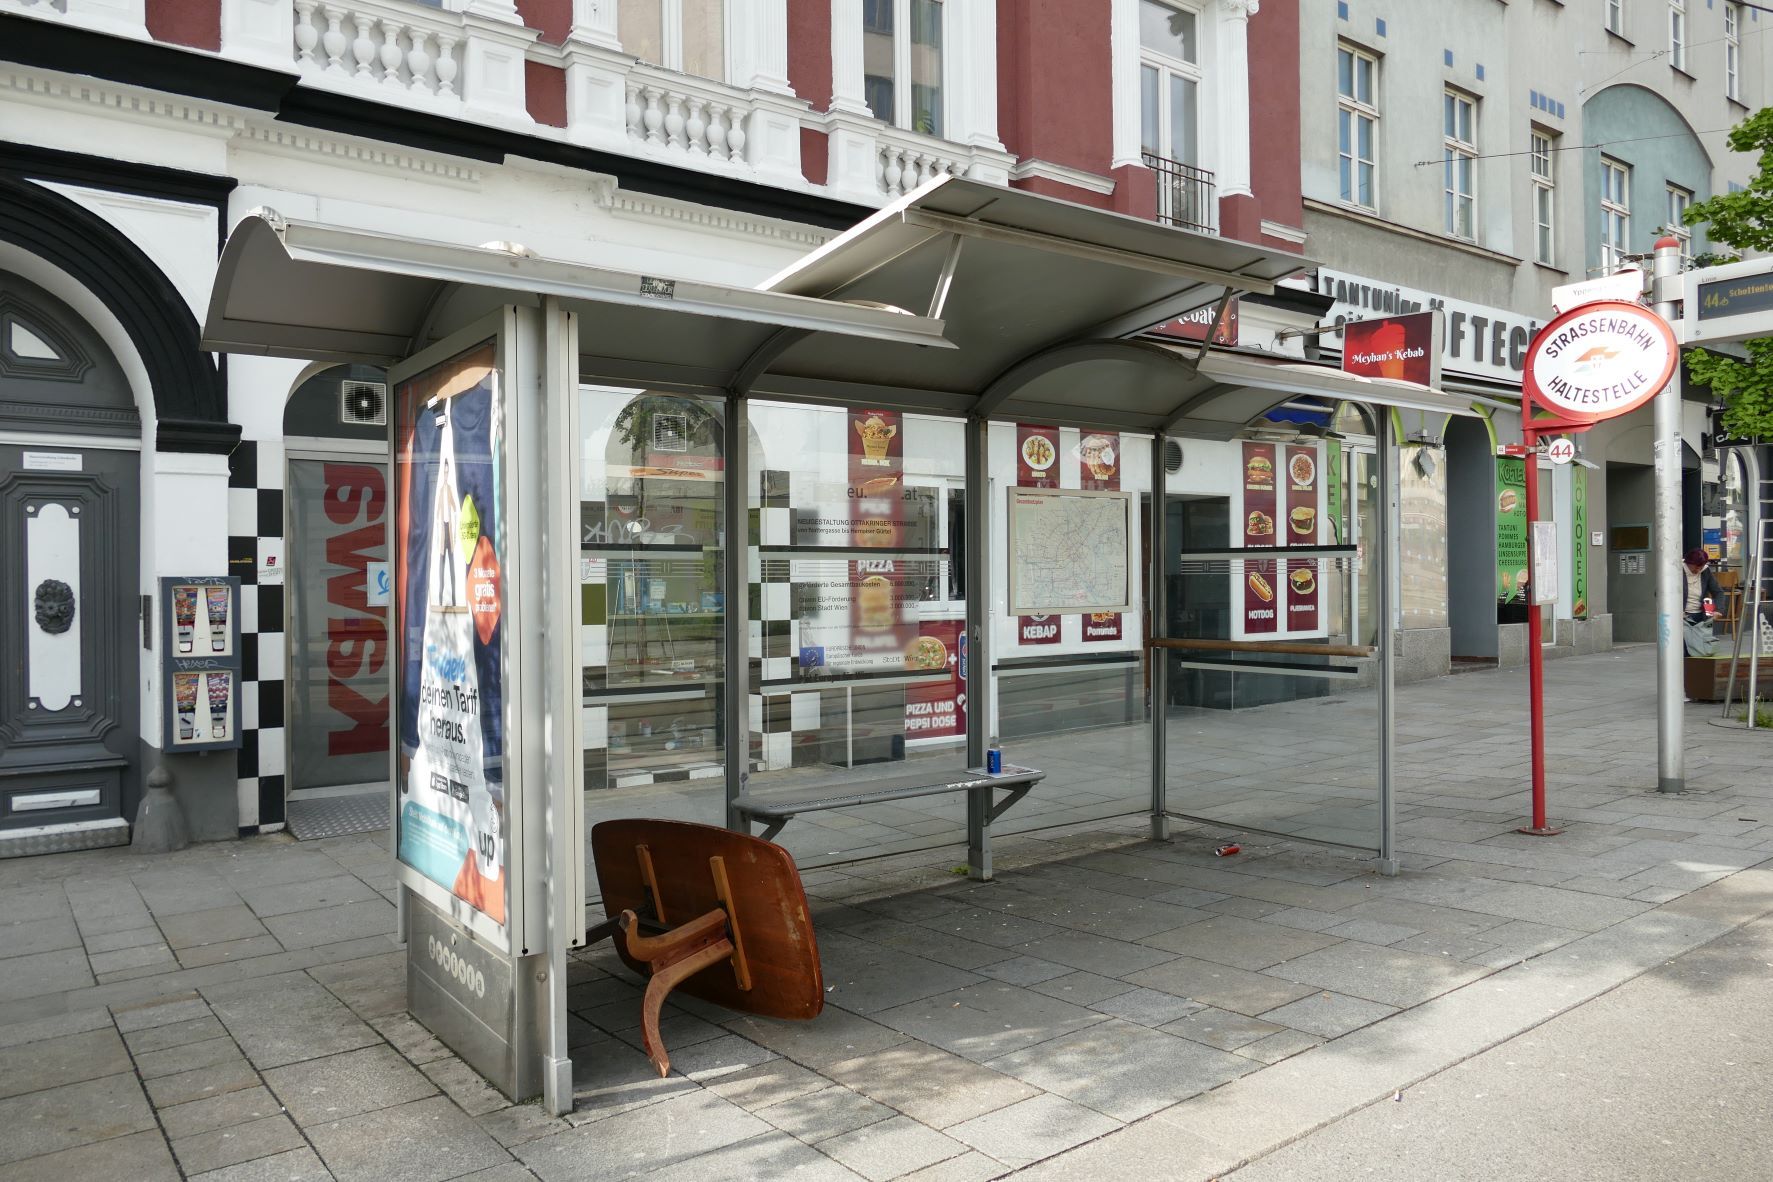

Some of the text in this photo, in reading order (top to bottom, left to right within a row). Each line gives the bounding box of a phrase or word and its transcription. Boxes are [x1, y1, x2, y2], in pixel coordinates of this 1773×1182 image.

[1704, 291, 1719, 309] 44
[1545, 318, 1656, 359] STRASSENBAHN
[1351, 347, 1424, 365] Meyhan's Kebab
[1547, 370, 1648, 404] HALTESTELLE
[1550, 444, 1572, 458] 44
[1575, 464, 1583, 598] KOKOREÇ
[857, 559, 895, 573] PIZZA
[475, 581, 495, 601] gratis
[833, 603, 848, 611] Wien
[1248, 610, 1274, 620] HOTDOG
[1023, 625, 1057, 639] KEBAP
[421, 679, 478, 716] deinen Tarif
[906, 701, 955, 715] PIZZA UND
[430, 709, 467, 745] heraus.
[904, 715, 957, 730] PEPSI DOSE
